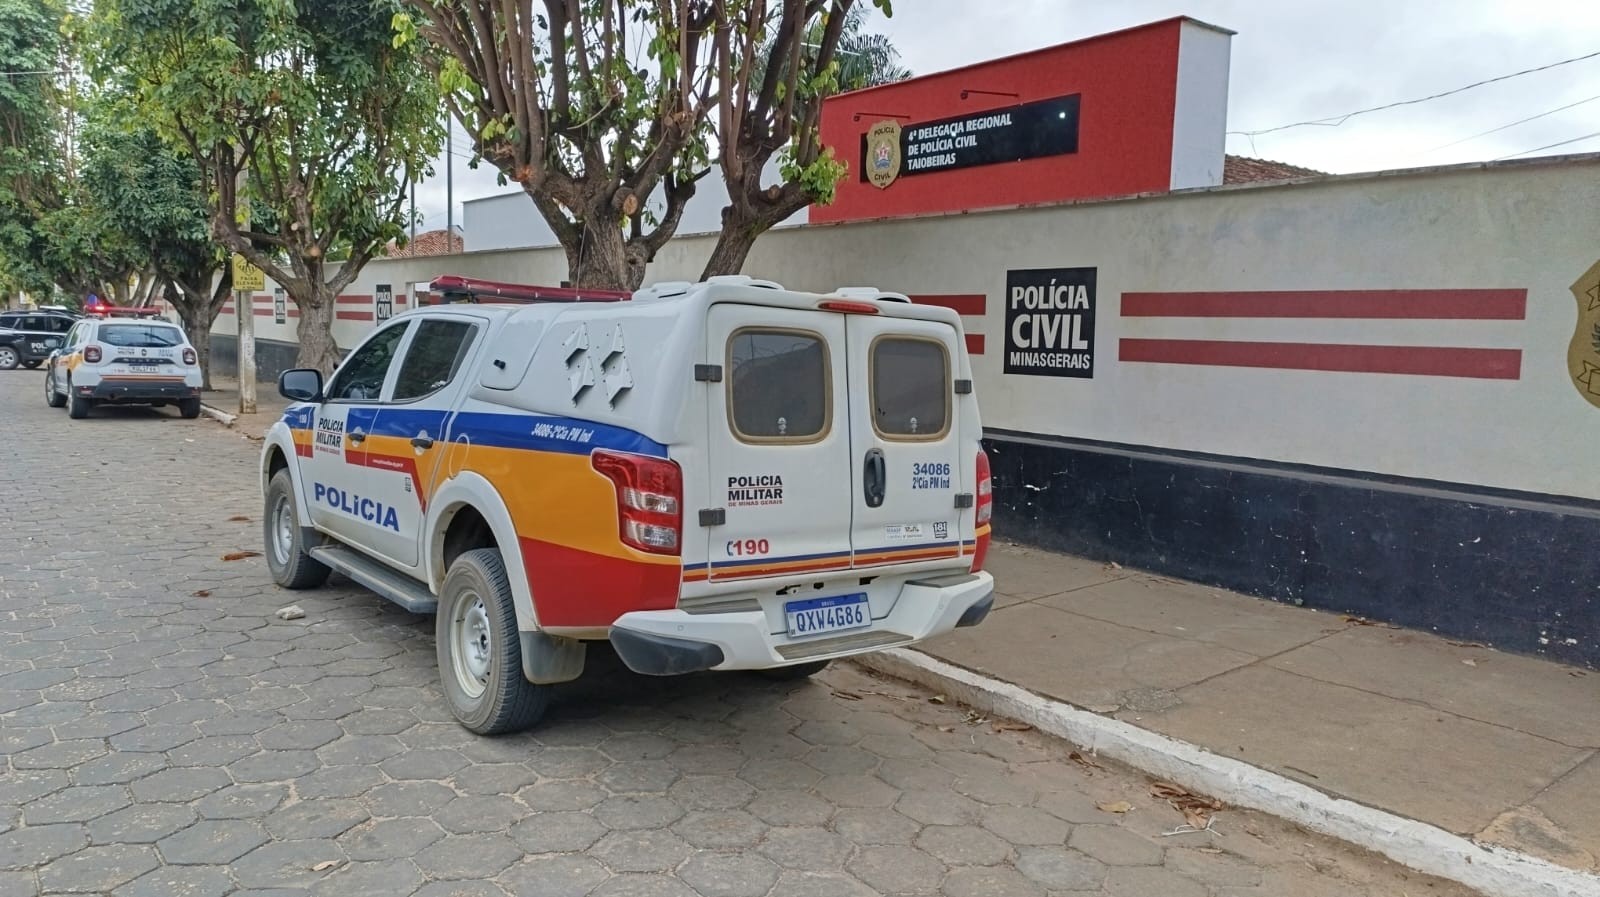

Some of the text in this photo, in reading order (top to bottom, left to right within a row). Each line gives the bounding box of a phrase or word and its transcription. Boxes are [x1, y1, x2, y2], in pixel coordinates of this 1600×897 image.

[966, 113, 1012, 132] REGIONAL
[908, 135, 977, 156] DE POLÍCIA CIVIL
[907, 153, 956, 170] TAIOBEIRAS
[1011, 279, 1090, 310] POLÍCIA
[1012, 314, 1088, 350] CIVIL
[316, 431, 342, 448] MILITAR
[913, 463, 950, 476] 34086
[930, 477, 939, 488] PM
[940, 477, 950, 488] Ind
[728, 488, 783, 501] MILITAR
[934, 522, 947, 532] 181
[733, 539, 769, 556] 190
[796, 604, 863, 632] QXW4G86
